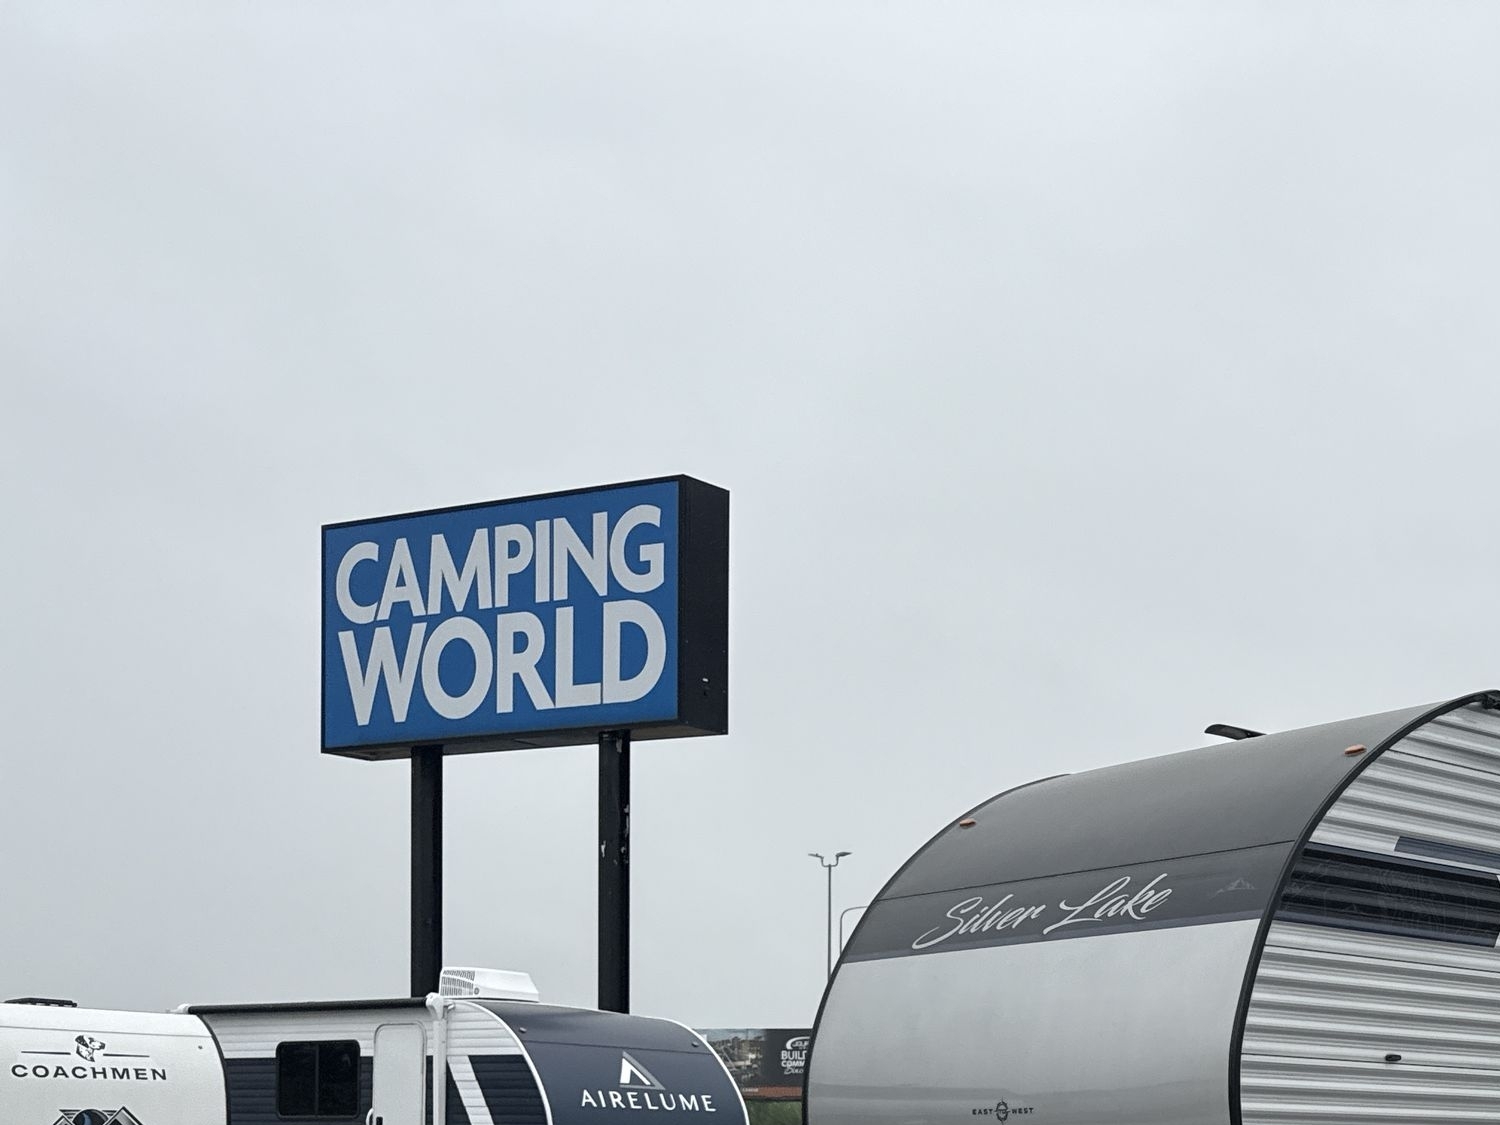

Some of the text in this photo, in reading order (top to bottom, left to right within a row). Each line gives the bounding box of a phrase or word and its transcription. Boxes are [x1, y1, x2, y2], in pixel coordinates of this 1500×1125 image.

[336, 504, 665, 624] CAMPING
[338, 599, 667, 726] WORLD
[911, 873, 1172, 949] Silver Lake
[11, 1064, 167, 1080] COACHMEN
[581, 1089, 717, 1112] AIRELUME
